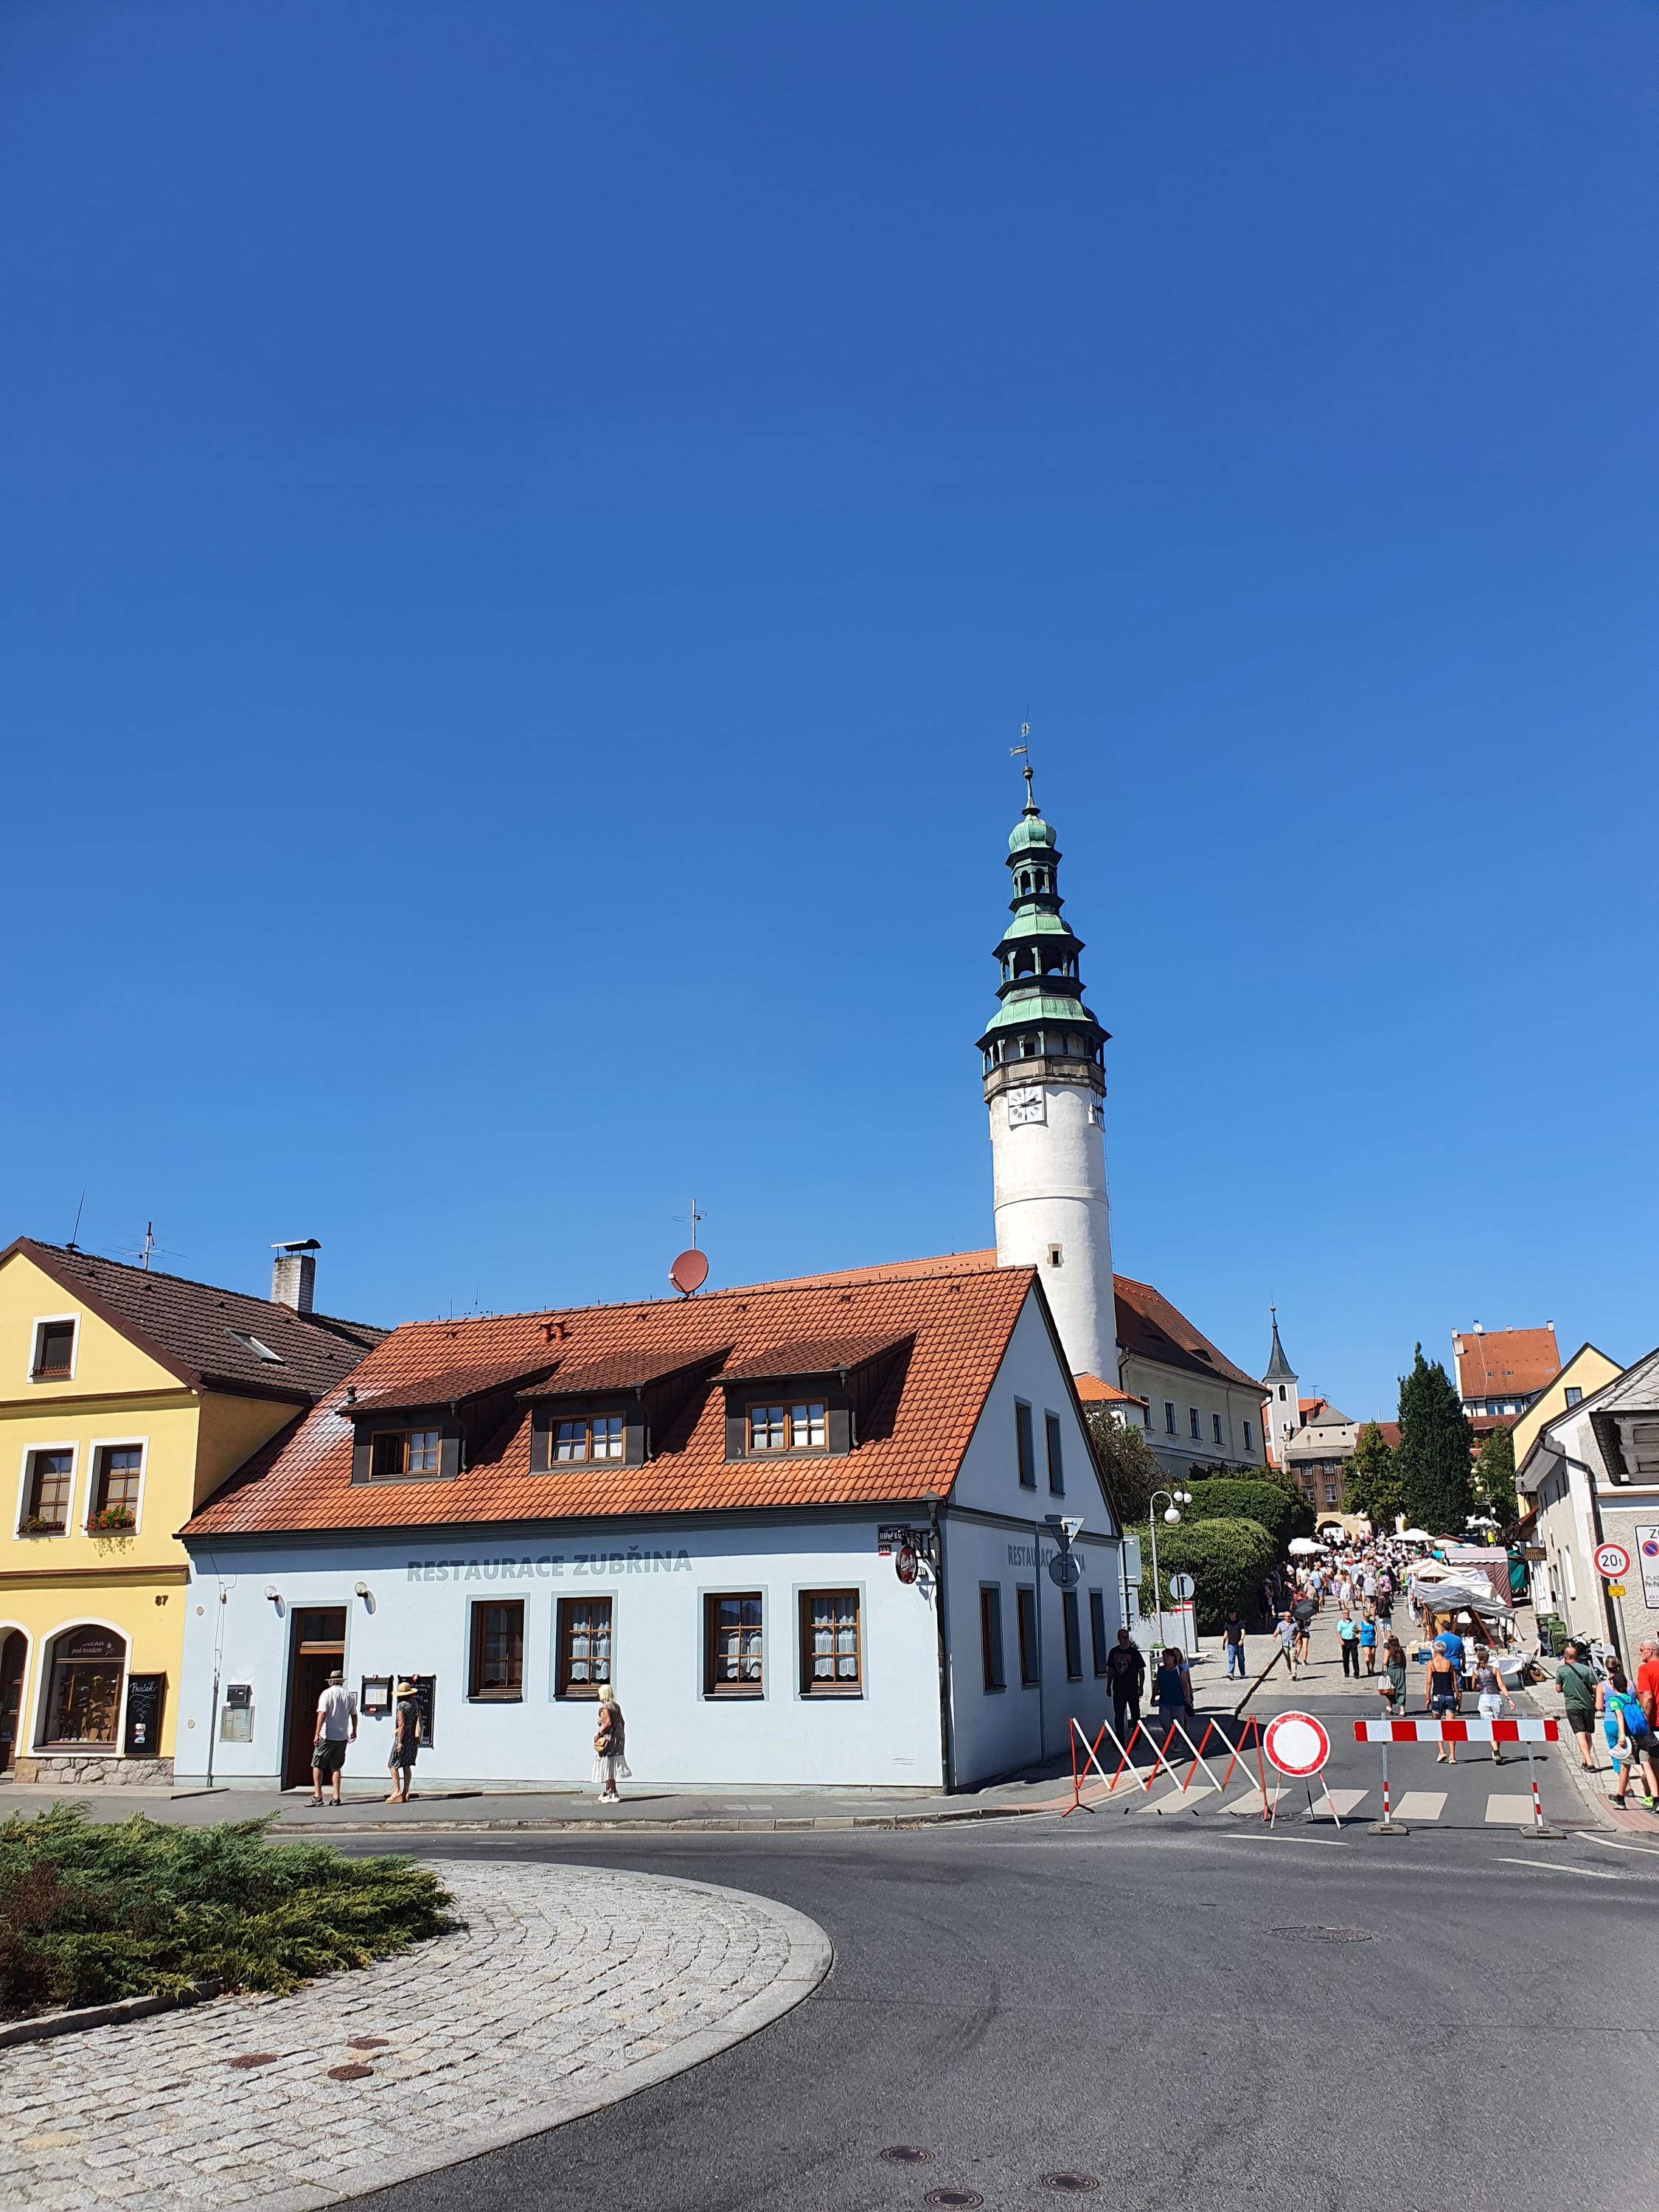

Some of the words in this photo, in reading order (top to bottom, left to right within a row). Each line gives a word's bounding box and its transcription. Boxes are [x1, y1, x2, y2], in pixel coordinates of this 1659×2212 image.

[1649, 1528, 1659, 1539] Z
[407, 1555, 564, 1582] RESTAURACE
[573, 1545, 692, 1576] ZUBŘINA
